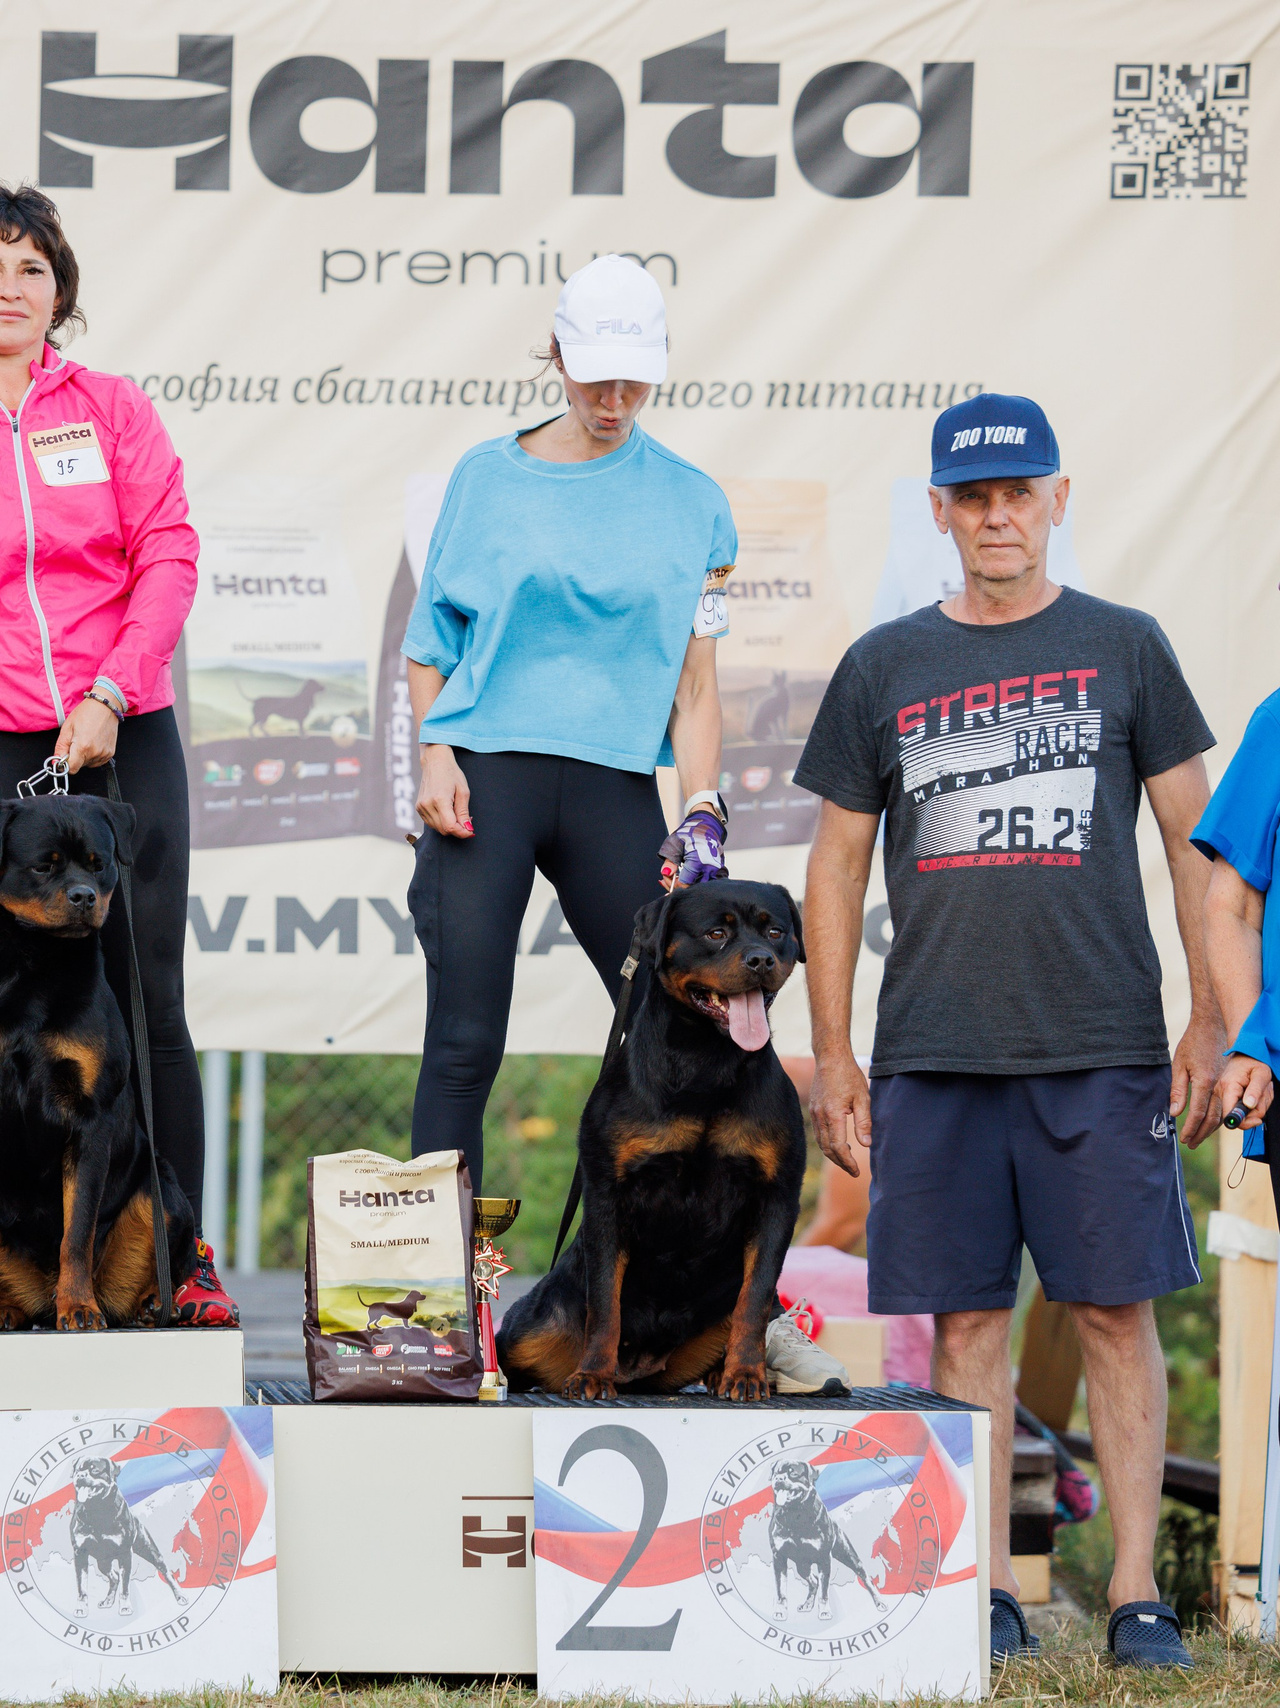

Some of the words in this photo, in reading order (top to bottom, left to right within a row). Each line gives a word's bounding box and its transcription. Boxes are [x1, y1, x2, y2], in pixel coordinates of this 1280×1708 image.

[38, 29, 976, 200] Hanta
[595, 317, 642, 336] FILA
[123, 362, 280, 413] софия
[32, 428, 92, 448] Hanta
[950, 427, 982, 452] ZOO
[983, 426, 1028, 445] YORK
[57, 458, 80, 476] 95
[213, 573, 328, 598] Hanta
[728, 577, 812, 600] anta
[896, 668, 1099, 748] STREET
[1015, 720, 1090, 761] RACE
[913, 753, 1088, 804] MARATHON
[977, 806, 1074, 851] 26.2
[339, 1189, 435, 1208] Hanta
[370, 1210, 407, 1218] premium
[350, 1237, 430, 1249] SMALL/MEDIUM
[6, 1428, 94, 1595] РОТВЕЙЛЕР
[112, 1423, 194, 1459] КЛУБ
[198, 1464, 238, 1591] РОССИИ
[705, 1431, 792, 1596] РОТВЕЙЛЕР
[810, 1427, 891, 1465] КЛУБ
[897, 1471, 937, 1598] РОССИИ
[462, 1515, 535, 1568] H
[555, 1423, 683, 1651] 2
[63, 1615, 190, 1653] РКФ-НКПР
[763, 1622, 890, 1657] РКФ-НКПР
